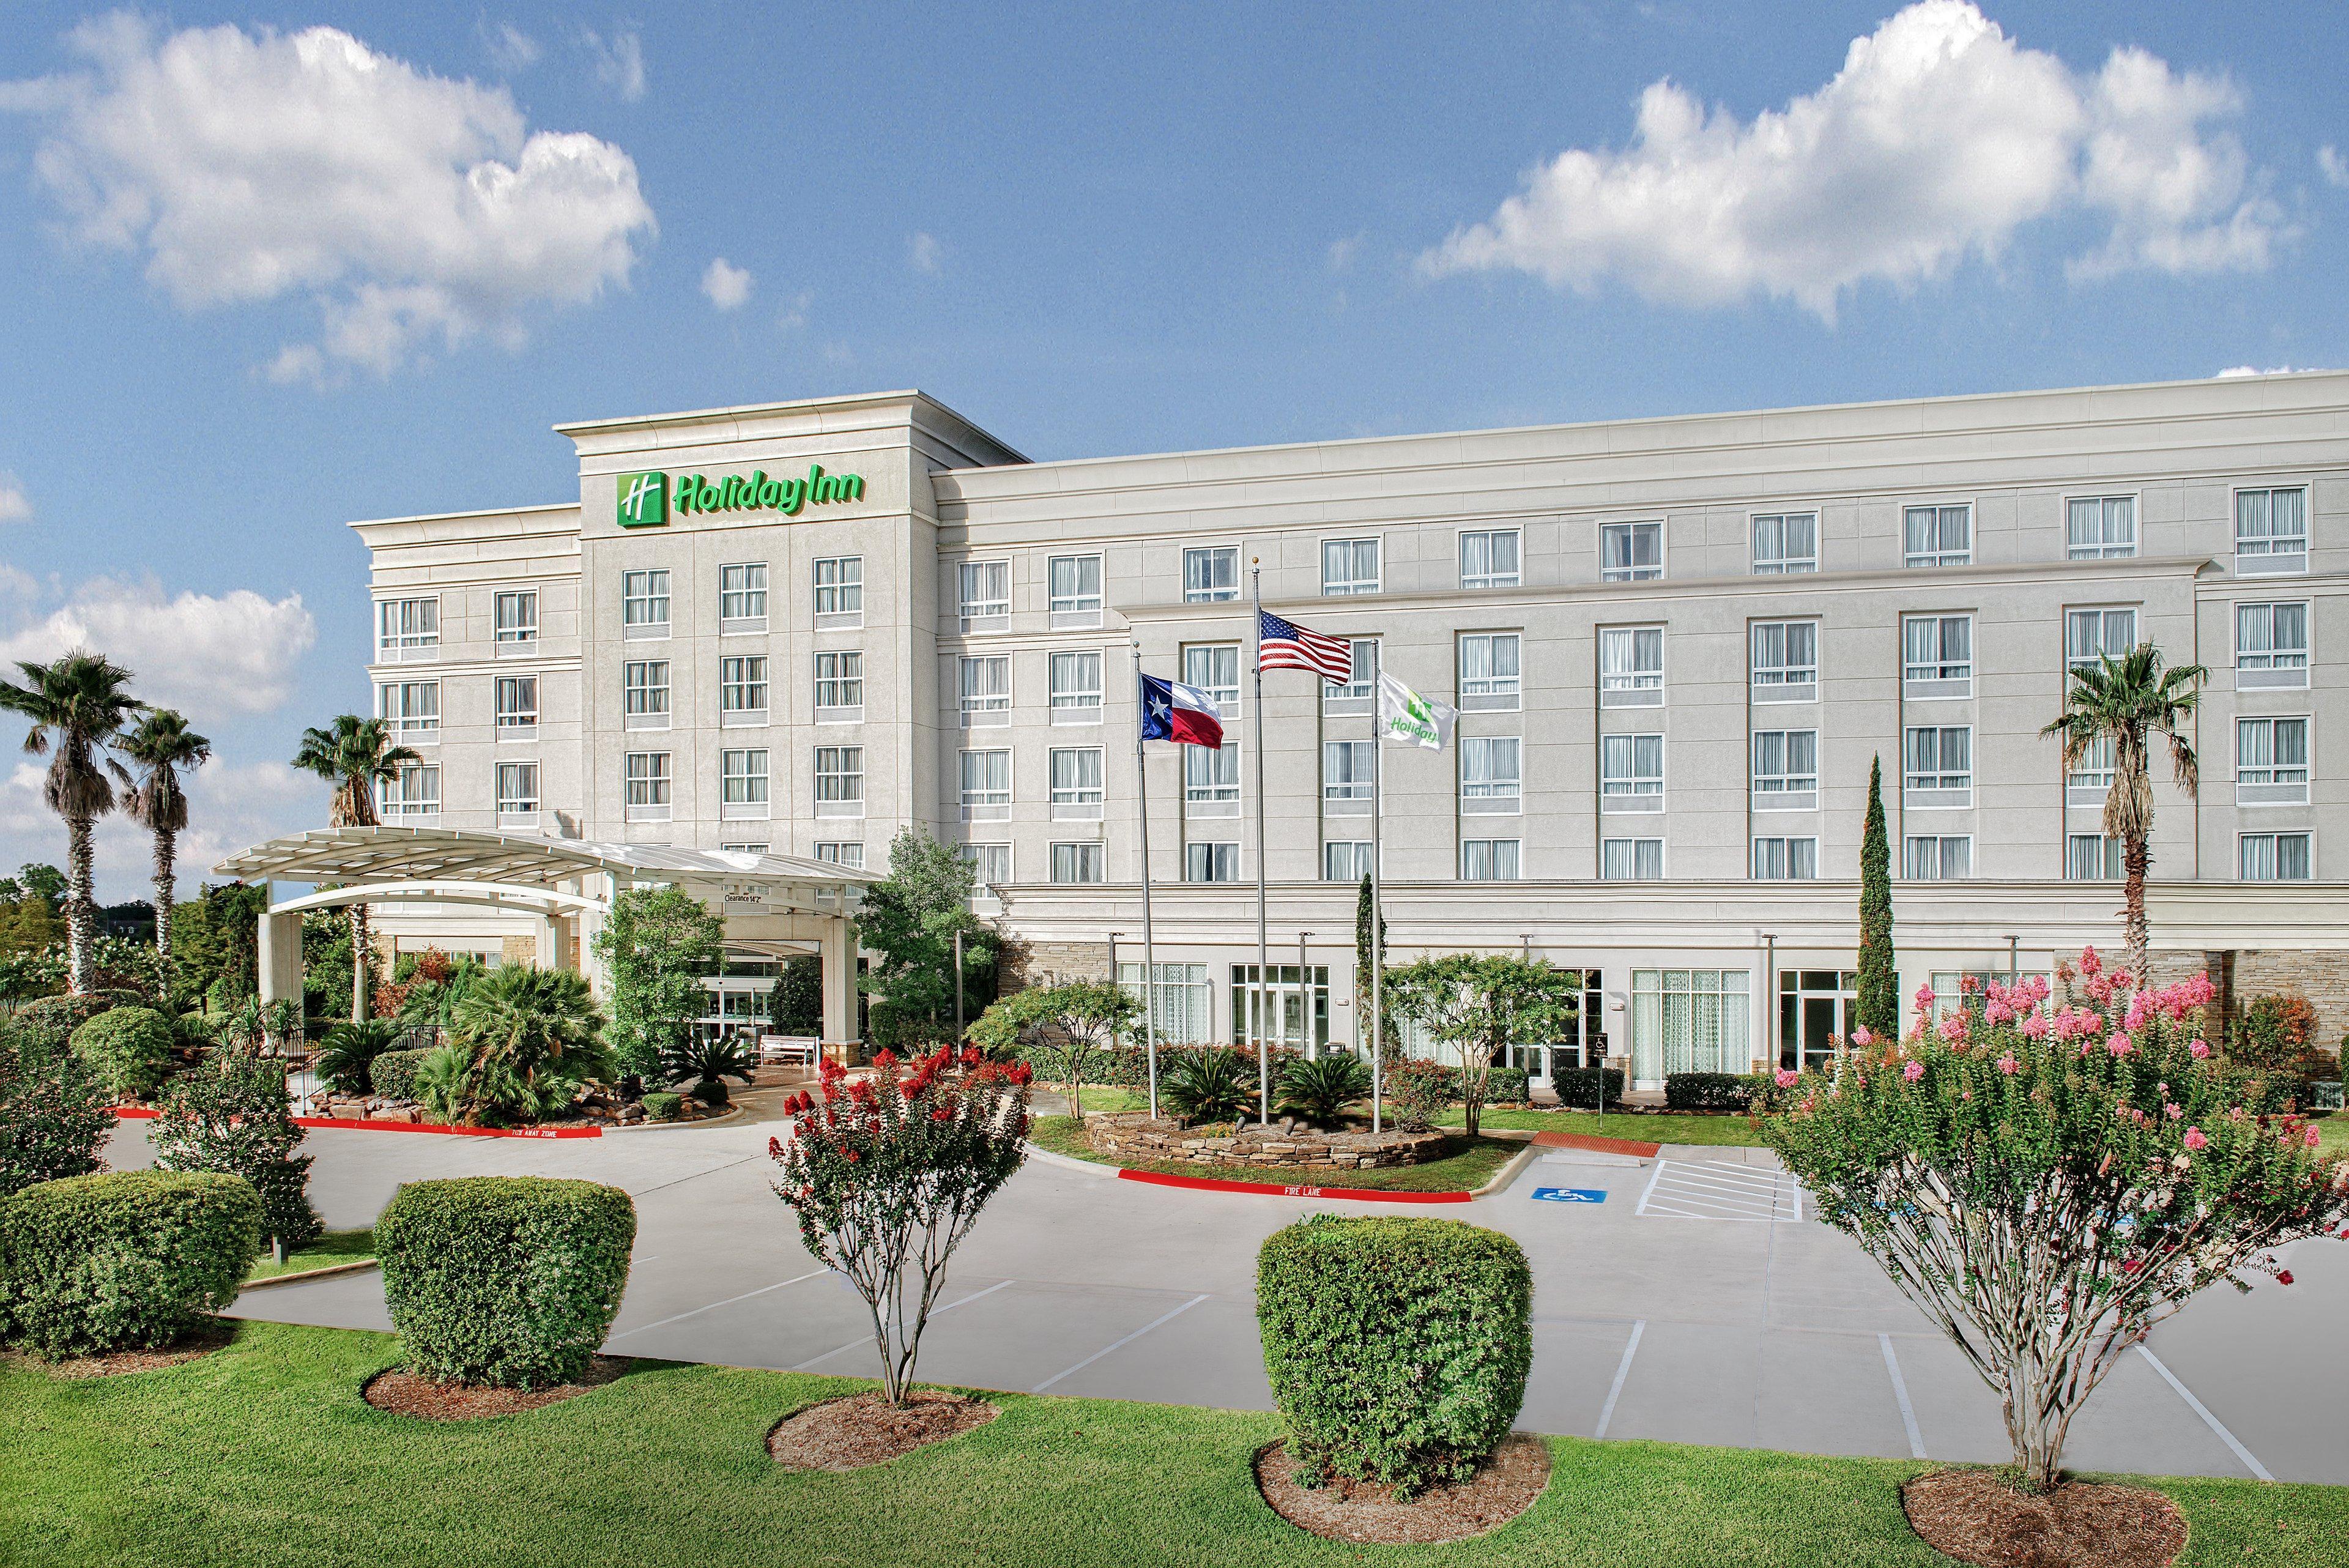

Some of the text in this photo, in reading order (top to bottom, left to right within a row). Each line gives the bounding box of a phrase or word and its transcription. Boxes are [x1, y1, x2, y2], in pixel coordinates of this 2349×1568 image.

[672, 464, 864, 516] Holiday Inn
[1390, 717, 1437, 743] Holiday
[1285, 1187, 1321, 1197] FIRE LANE
